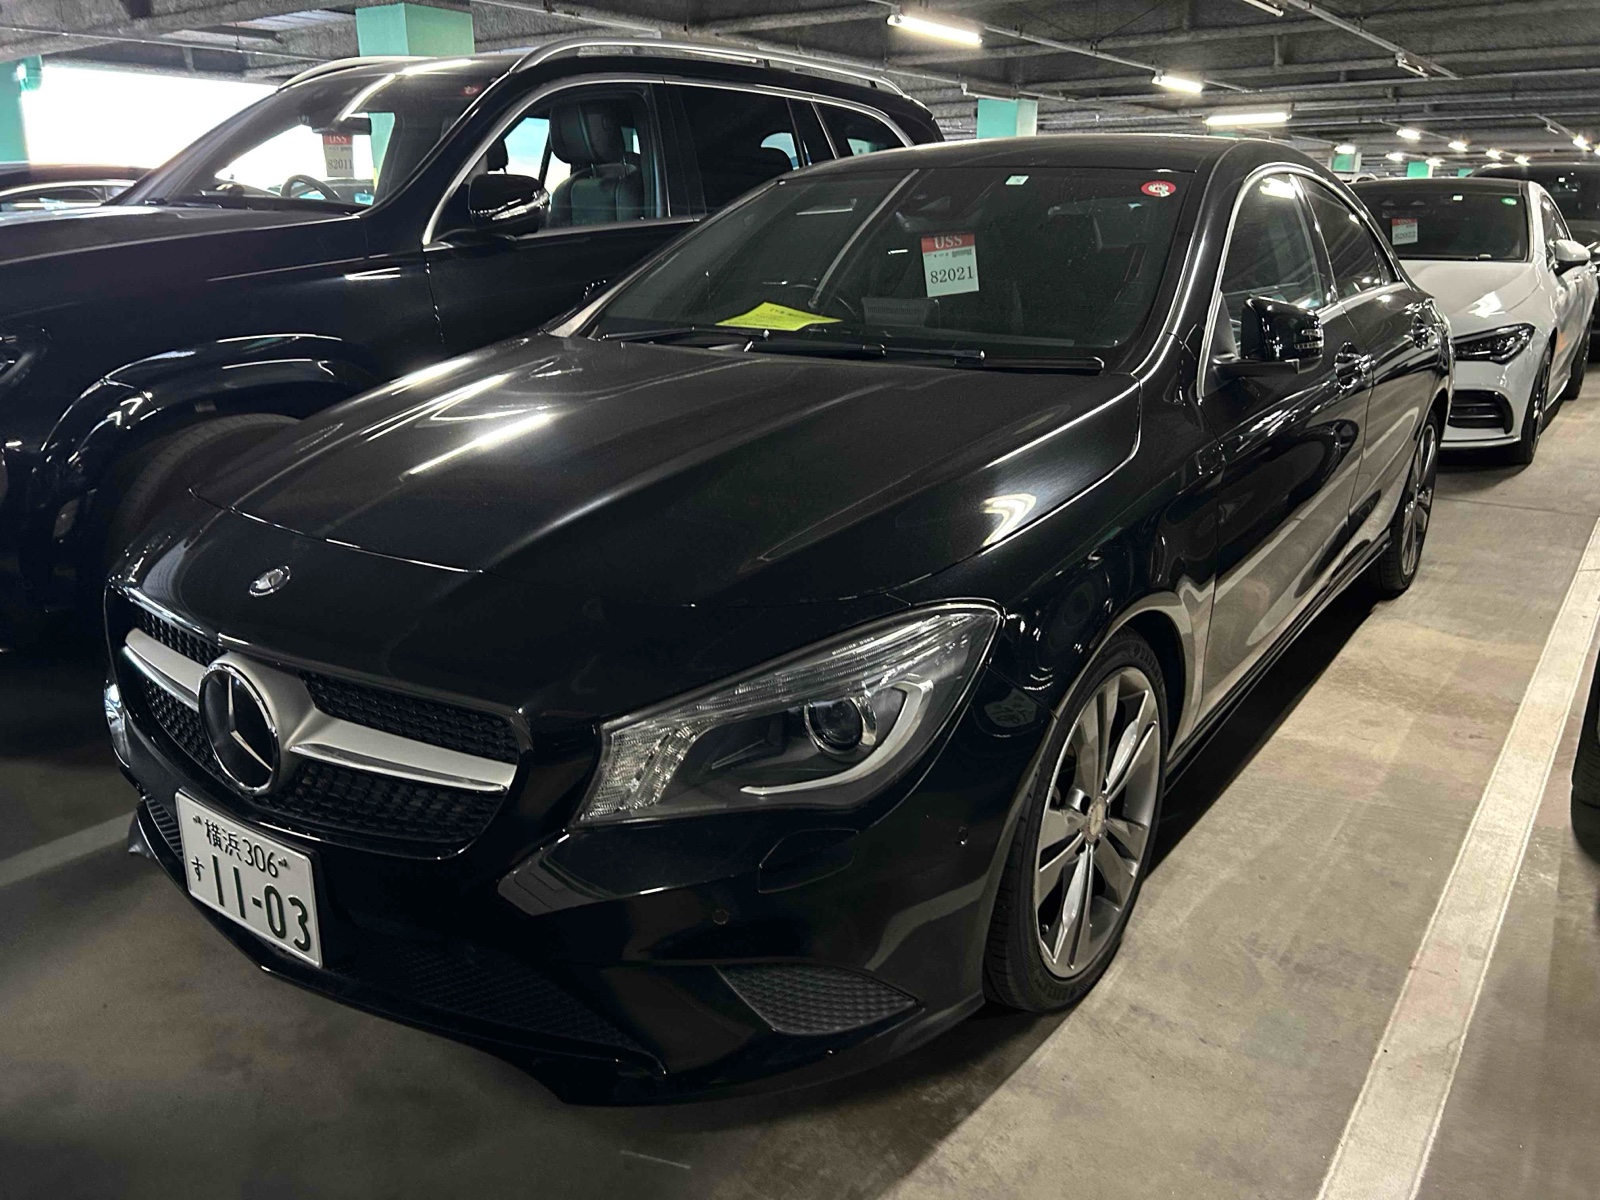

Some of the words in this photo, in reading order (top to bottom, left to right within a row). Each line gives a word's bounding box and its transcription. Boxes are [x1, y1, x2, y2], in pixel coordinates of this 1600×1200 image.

[328, 159, 353, 170] 82011
[934, 233, 963, 250] USS
[930, 265, 974, 285] 82021
[190, 855, 205, 882] す
[211, 854, 312, 952] 11-03
